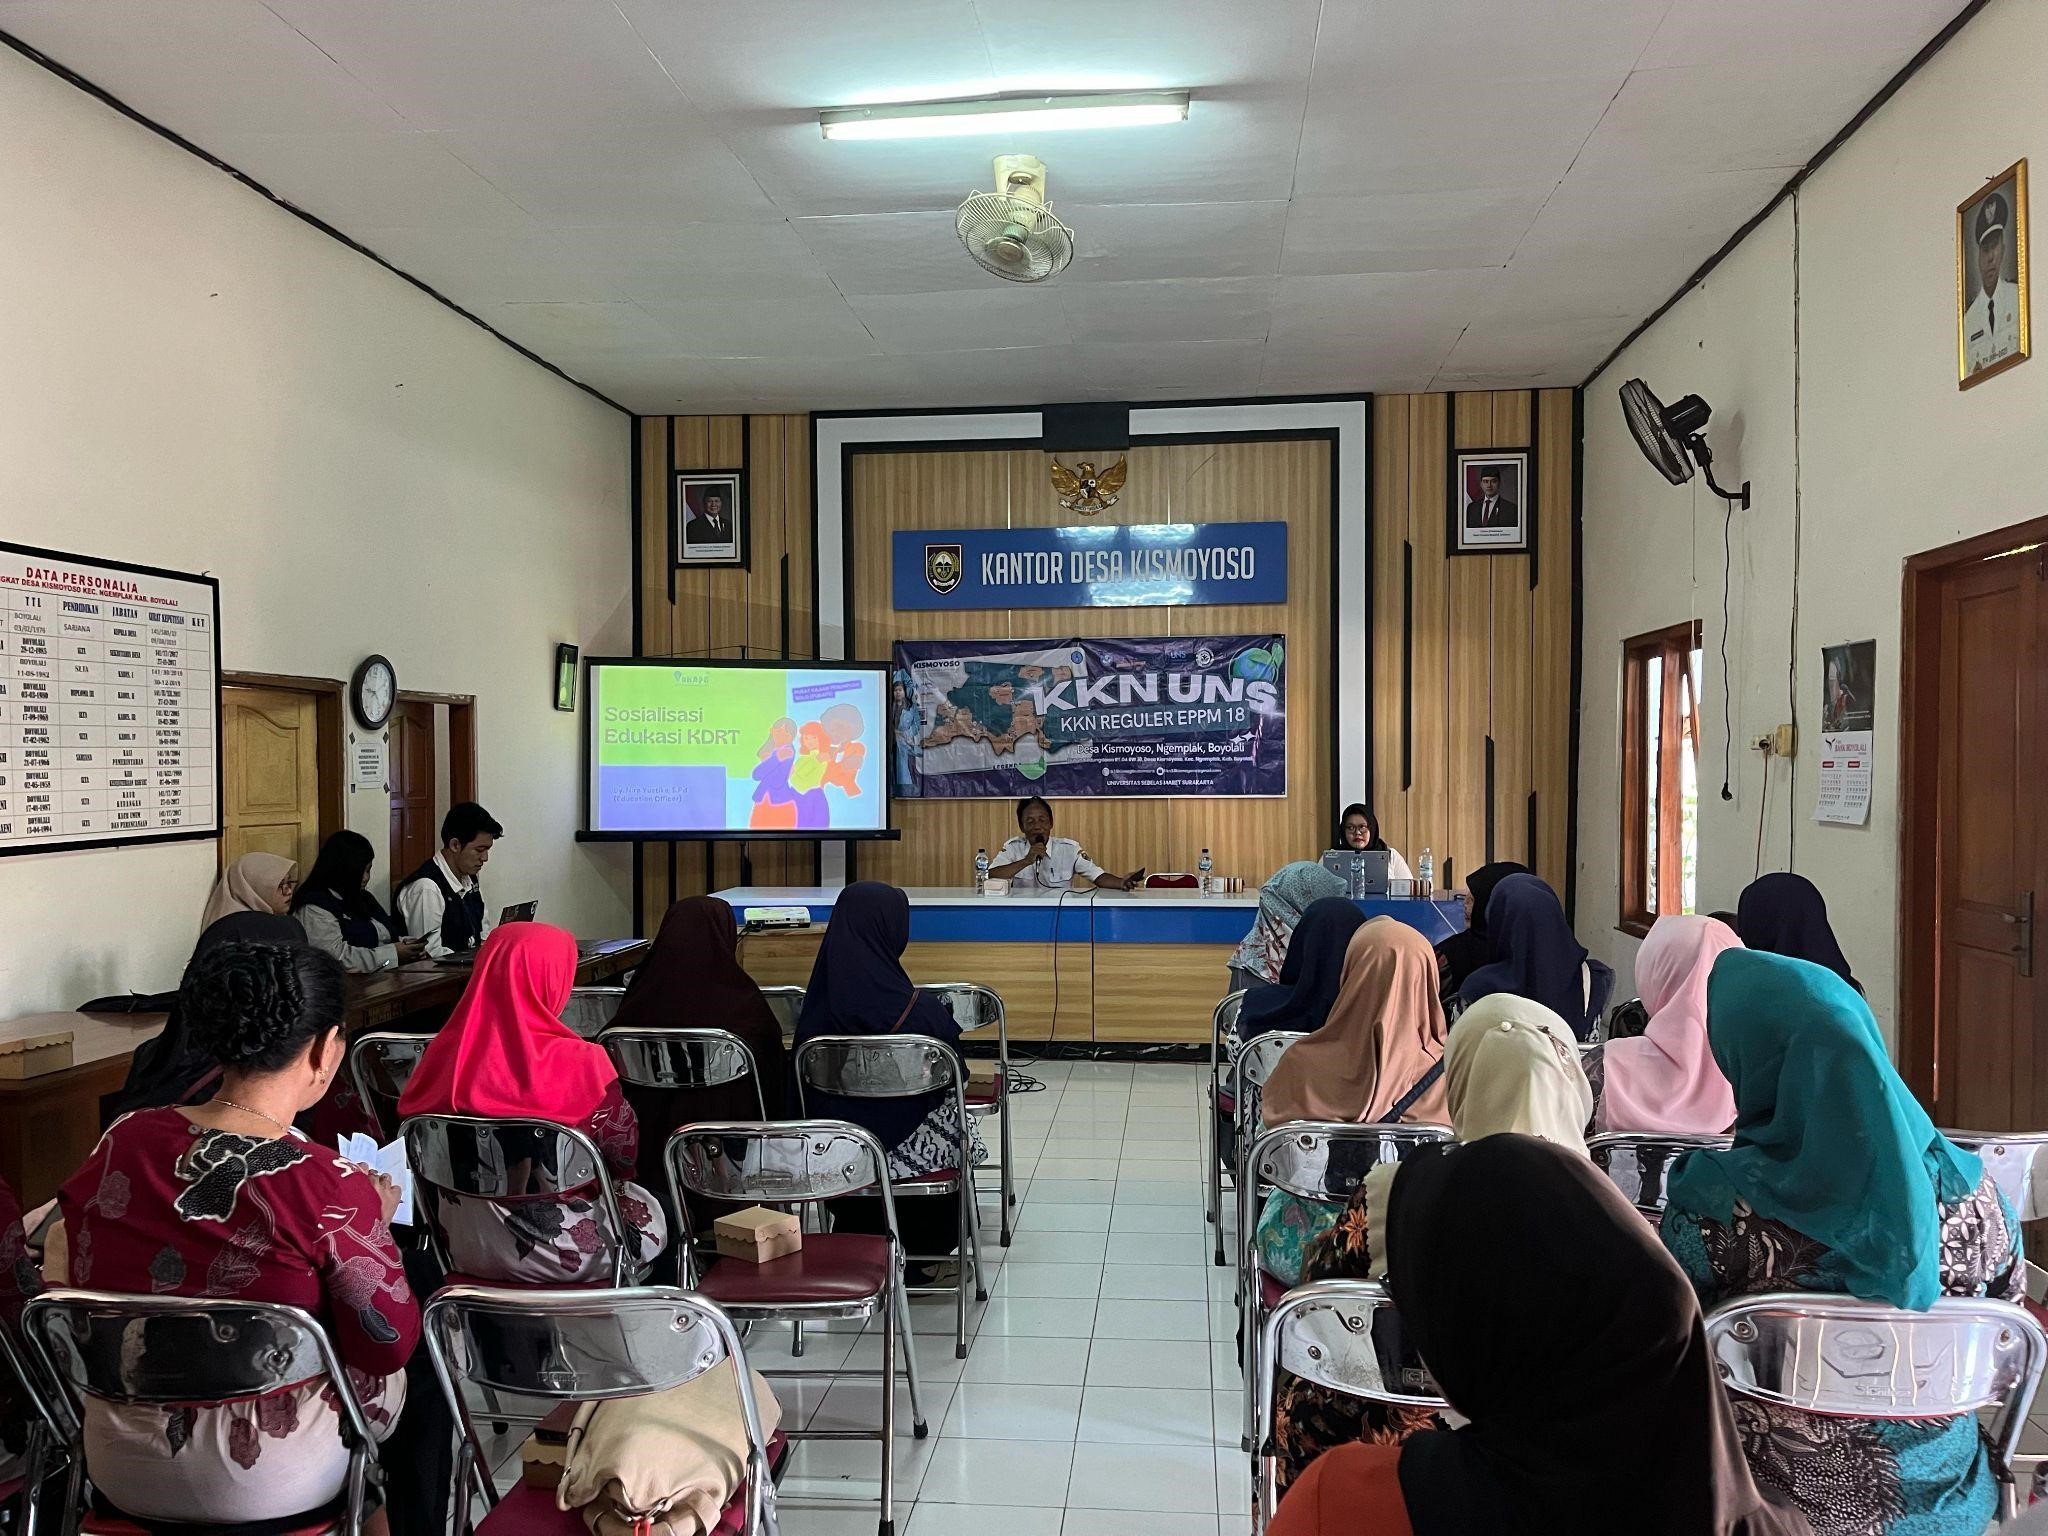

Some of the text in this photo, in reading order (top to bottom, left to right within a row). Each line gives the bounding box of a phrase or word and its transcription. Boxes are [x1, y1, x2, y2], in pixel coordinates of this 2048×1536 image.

[982, 547, 1255, 585] KANTOR DESA KISMOYOSO
[26, 567, 138, 593] DATA PERSONALIA
[22, 579, 40, 588] DESA
[42, 582, 81, 593] KISMOYOSO
[83, 588, 97, 596] KEC.
[99, 589, 133, 600] NGEMPLAK
[134, 595, 149, 603] KAB.
[150, 597, 179, 607] BOYOLALI
[63, 601, 99, 614] PENDIDIKAN
[112, 606, 138, 618] JABATAN
[64, 623, 91, 632] SARJANA
[914, 661, 960, 669] KISMOYOSO
[1032, 673, 1278, 715] KKN UNS
[605, 706, 703, 723] Sosialisasi
[1060, 707, 1245, 733] KKN REGULER EPPM 18
[605, 729, 740, 744] Edukasi KDRT
[1077, 743, 1245, 758] Desa Kismoyoso, Ngemplak, Boyolali
